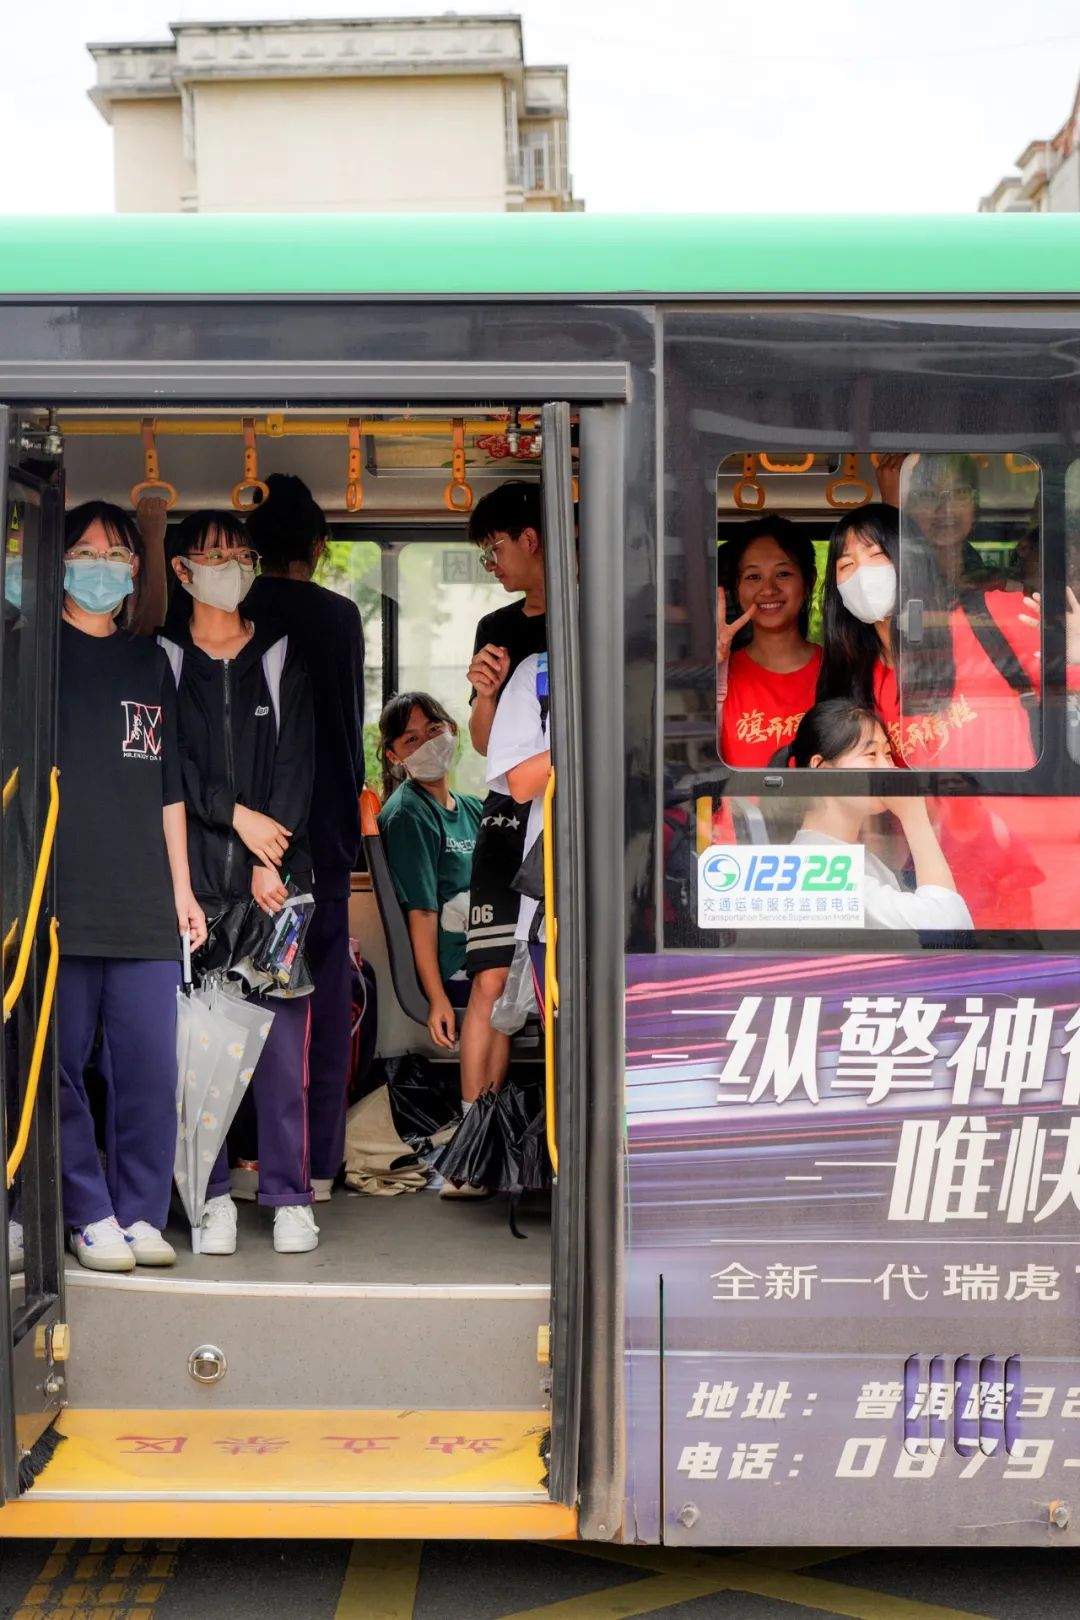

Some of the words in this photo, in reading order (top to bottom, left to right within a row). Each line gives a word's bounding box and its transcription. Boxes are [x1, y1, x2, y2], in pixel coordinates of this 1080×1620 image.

[744, 855, 856, 892] 12328
[471, 904, 494, 925] 06
[703, 897, 860, 912] 交通运输服务监督电话
[703, 913, 757, 923] Transportation
[759, 913, 788, 922] Service
[788, 913, 834, 923] Supervision
[834, 913, 860, 922] Hotline
[717, 996, 1080, 1105] 纵擎神
[888, 1116, 1080, 1223] 唯快
[710, 1261, 929, 1301] 全新一代
[943, 1263, 1061, 1302] 瑞虎
